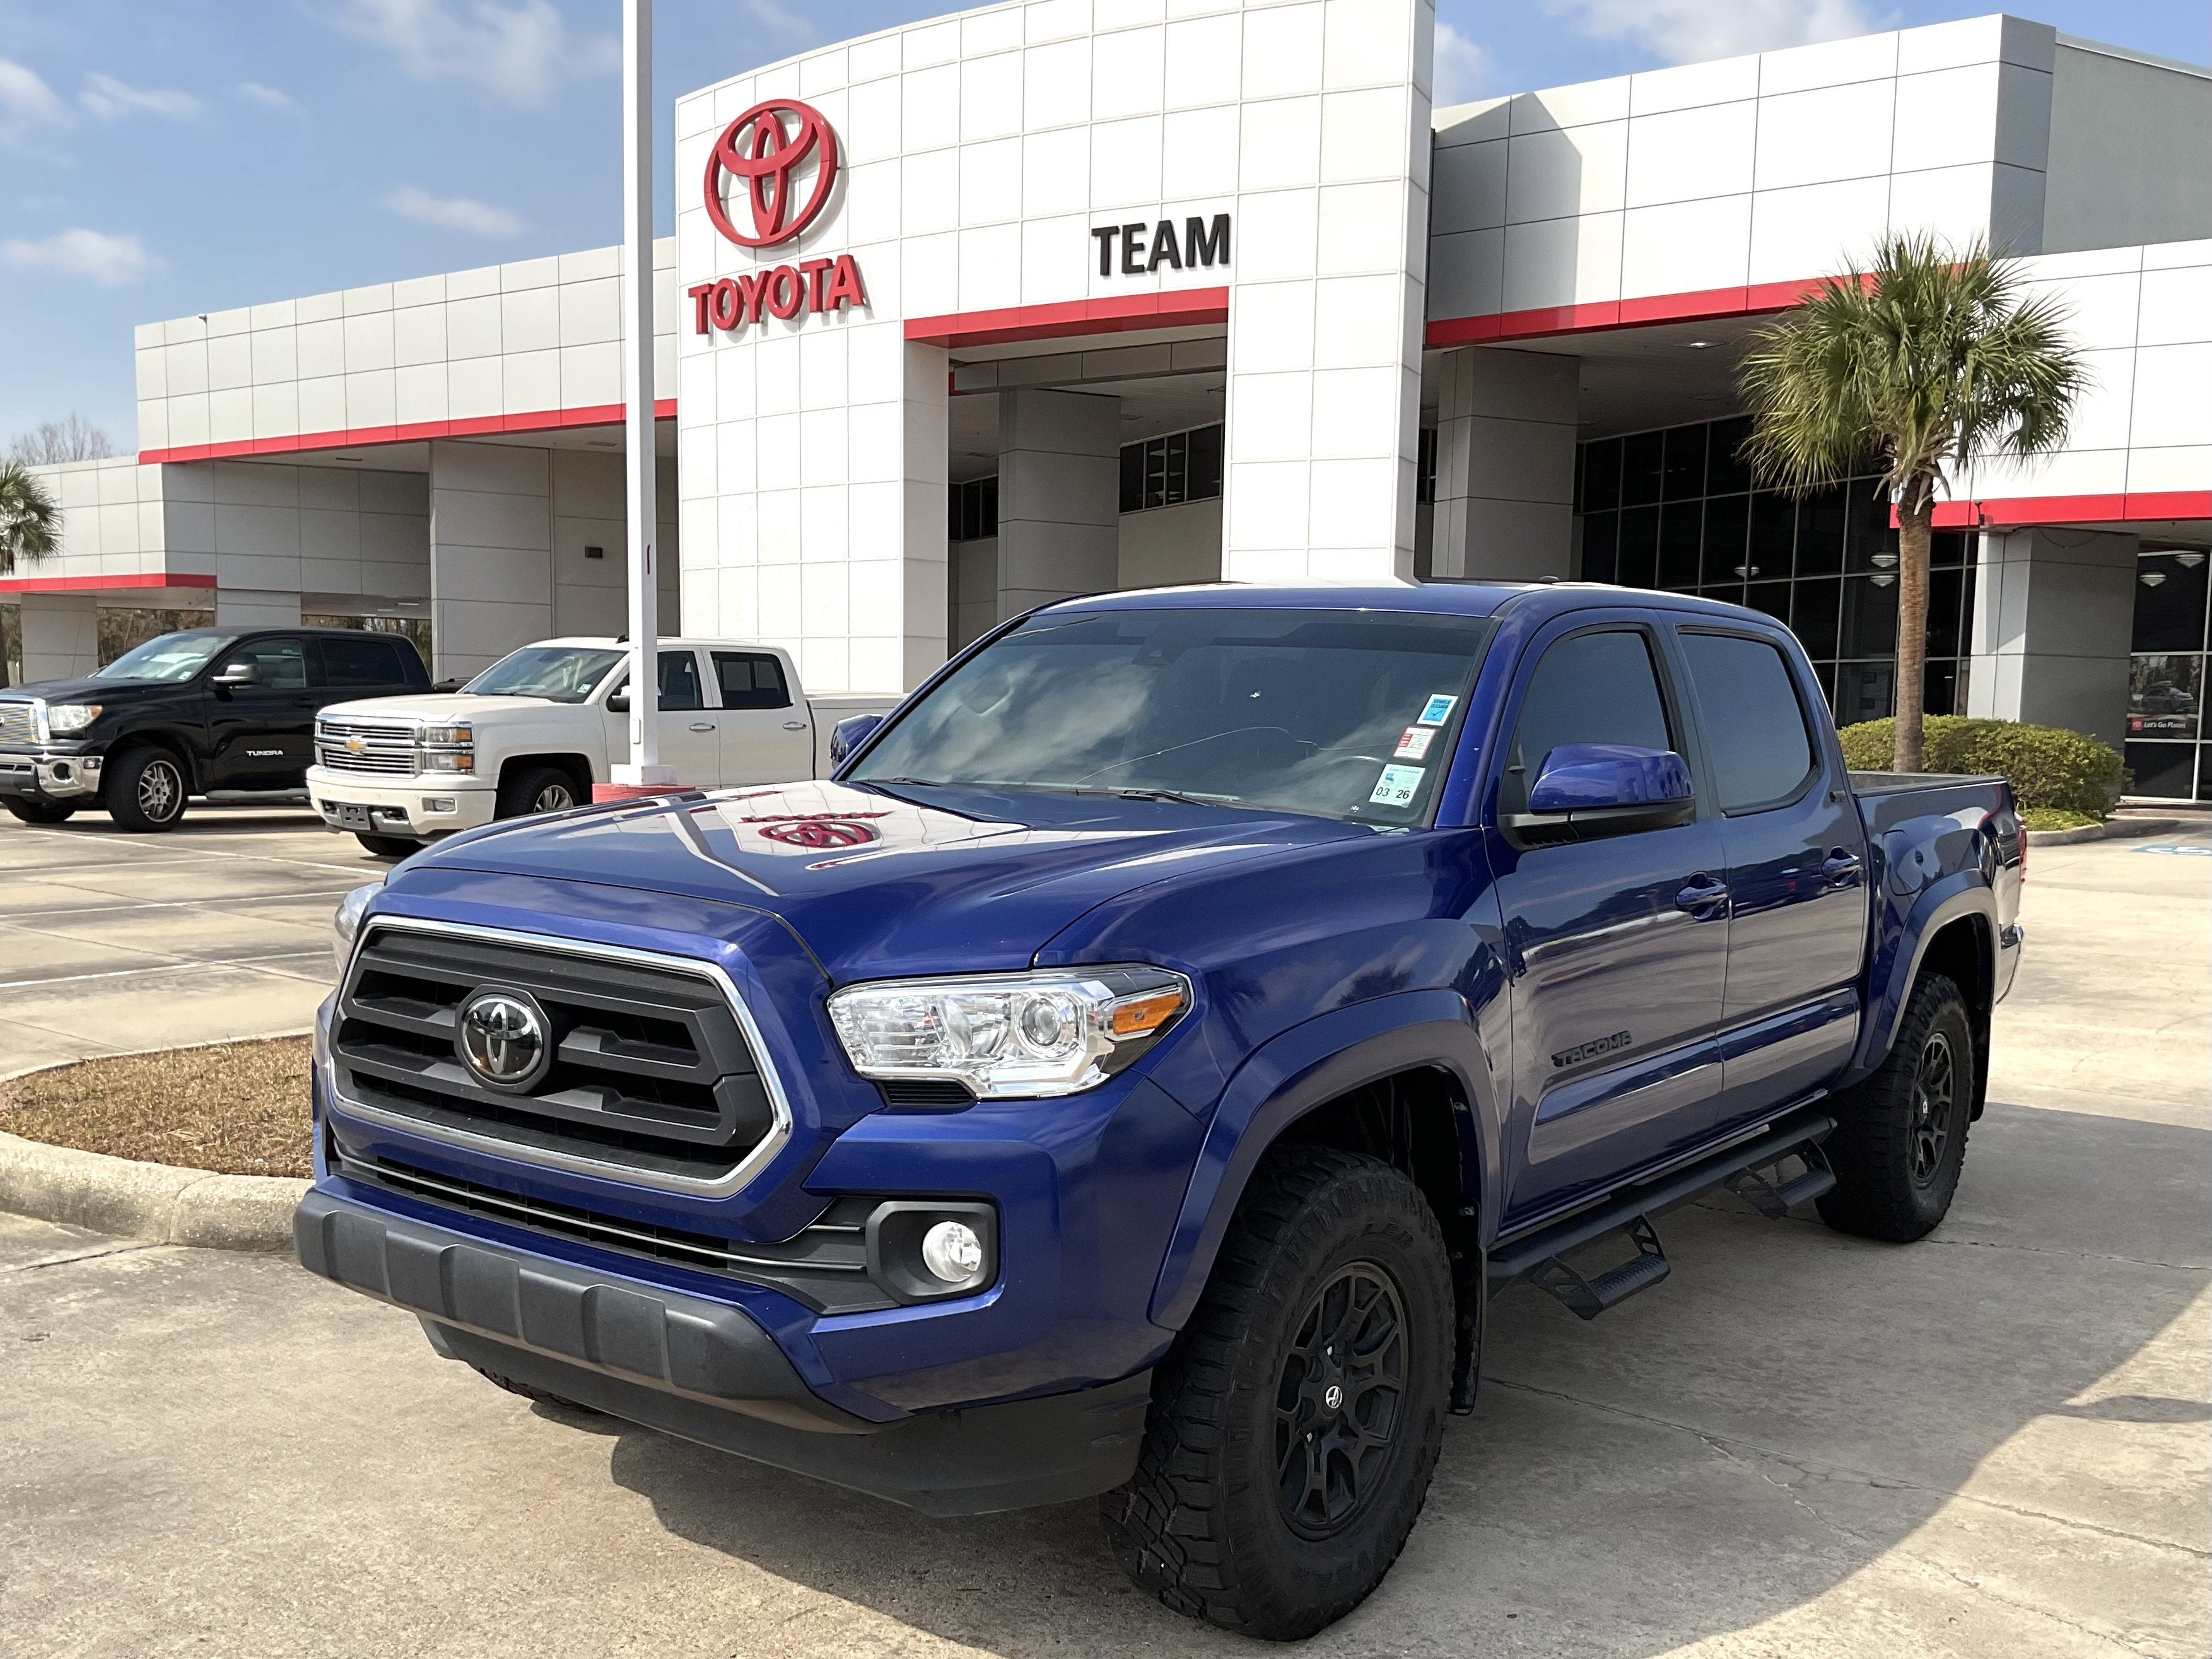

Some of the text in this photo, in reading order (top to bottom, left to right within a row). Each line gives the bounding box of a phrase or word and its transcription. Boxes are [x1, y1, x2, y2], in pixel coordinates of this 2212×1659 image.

[1091, 213, 1229, 276] TEAM
[688, 254, 867, 335] TOYOTA
[1376, 787, 1410, 799] 03 26
[1551, 1030, 1632, 1067] TACOMA
